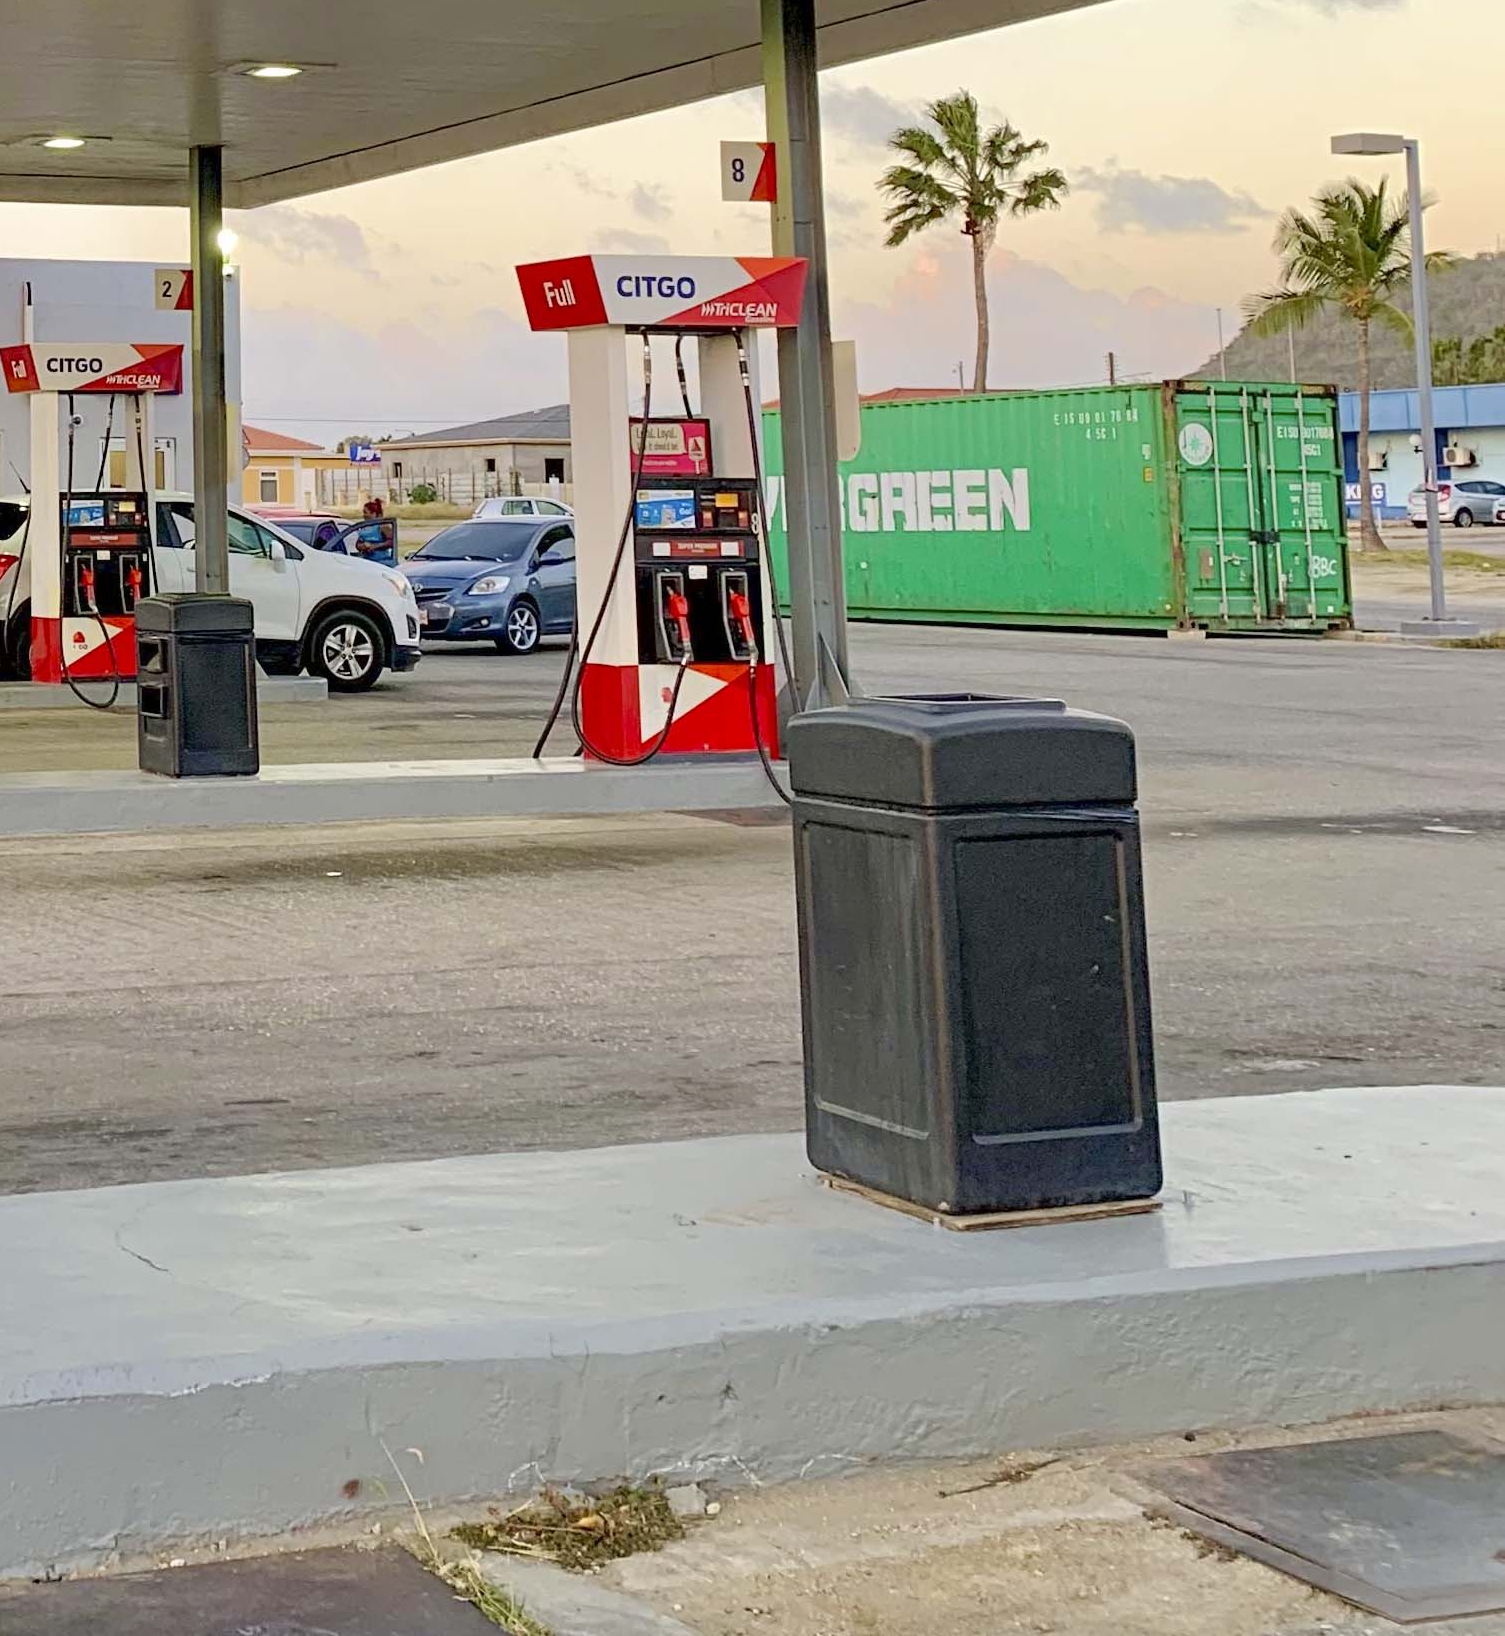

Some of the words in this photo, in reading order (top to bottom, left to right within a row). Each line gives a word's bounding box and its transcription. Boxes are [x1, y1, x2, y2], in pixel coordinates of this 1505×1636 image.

[731, 158, 745, 182] 8
[161, 280, 173, 298] 2
[543, 278, 576, 309] Full
[616, 275, 696, 299] CITGO
[46, 357, 103, 373] CITGO
[750, 512, 760, 535] 8
